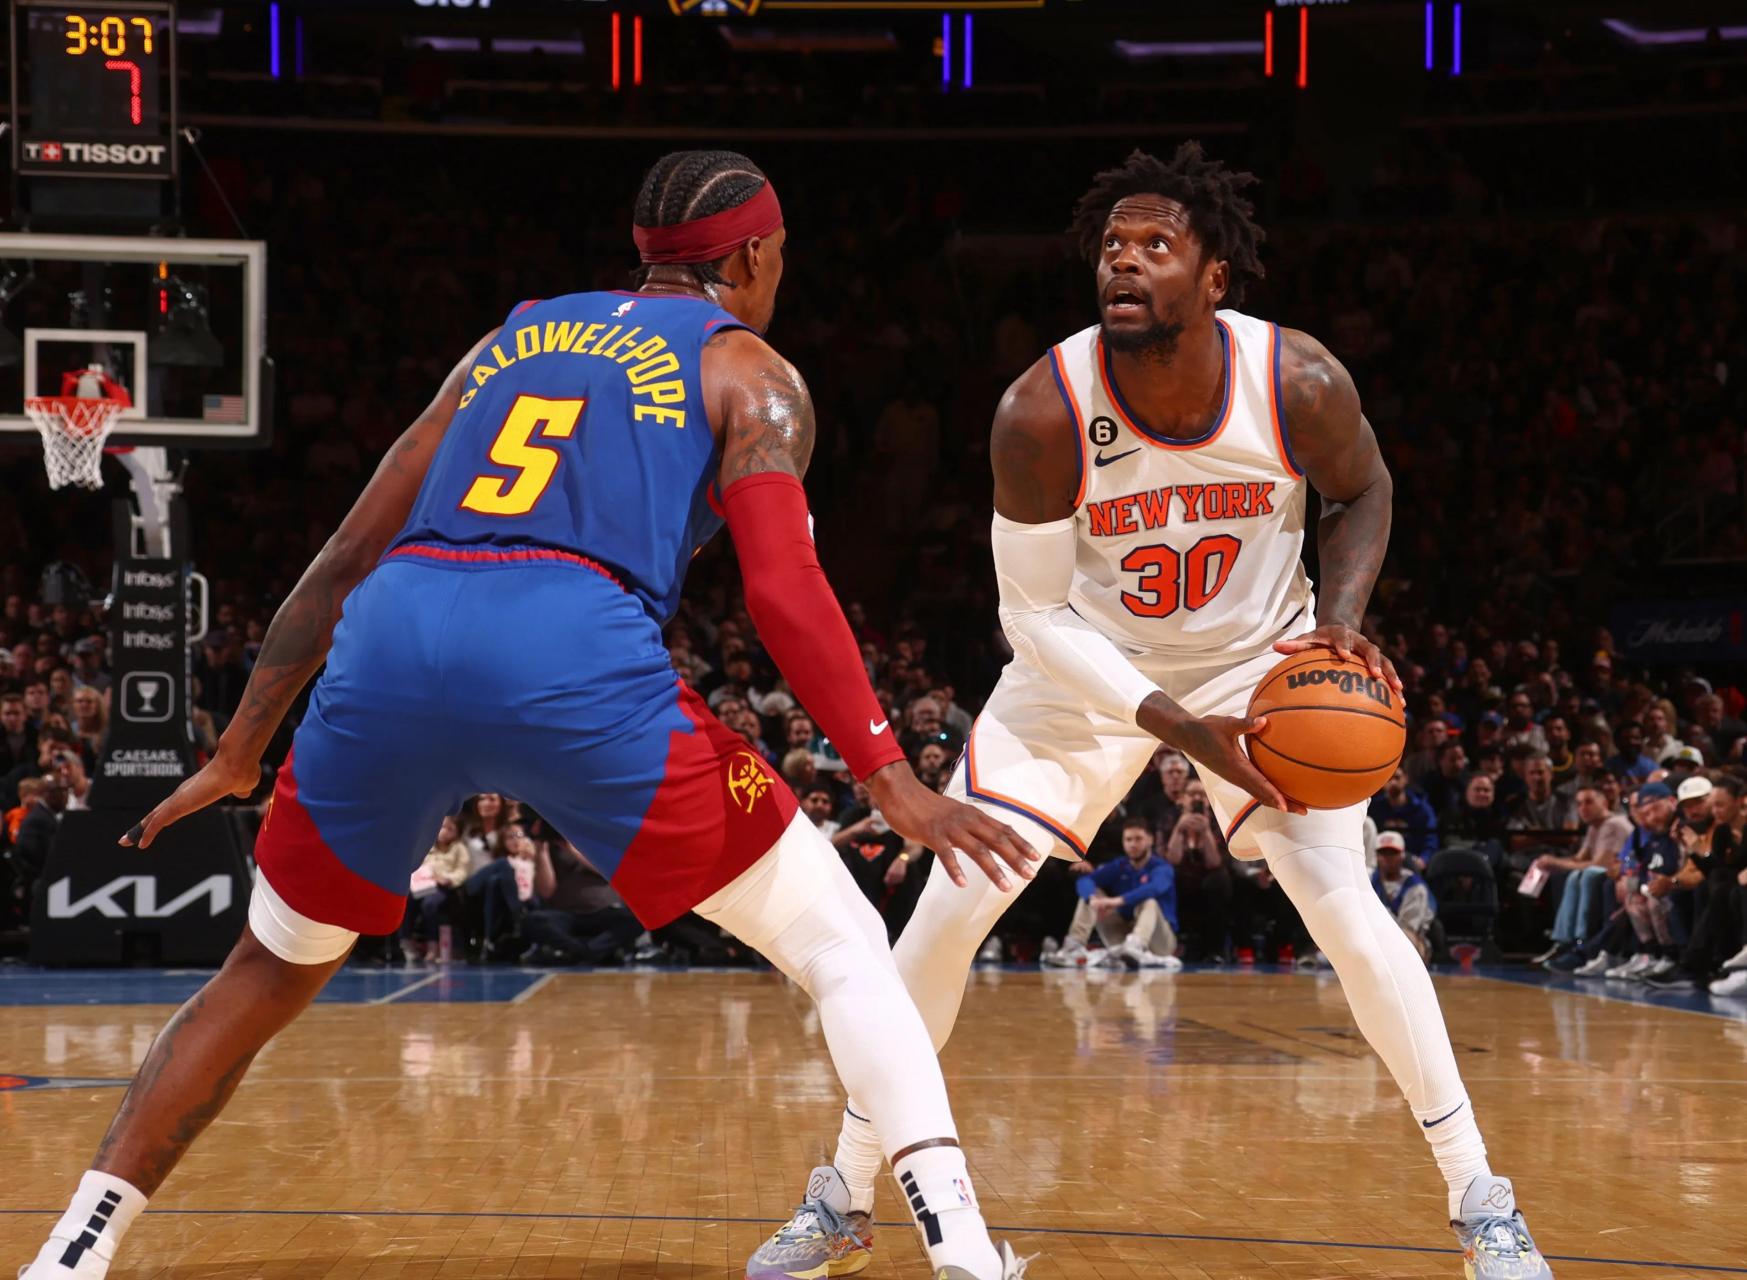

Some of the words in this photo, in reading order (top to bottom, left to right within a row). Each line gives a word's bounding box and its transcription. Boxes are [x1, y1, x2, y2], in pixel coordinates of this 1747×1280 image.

[65, 15, 153, 56] 3:07
[104, 61, 142, 126] 7
[63, 143, 166, 164] TISSOT
[1095, 421, 1111, 442] 6
[456, 392, 588, 518] 5
[1085, 486, 1173, 537] NEW
[1175, 481, 1275, 523] YORK
[123, 571, 175, 590] Infosys
[1120, 533, 1242, 619] 30
[122, 602, 174, 621] Infosys
[122, 631, 174, 650] Infosys
[1286, 669, 1392, 710] Wilson
[103, 763, 184, 778] SPORTSBOOK
[111, 750, 178, 763] CAESARS
[47, 875, 232, 919] KIA
